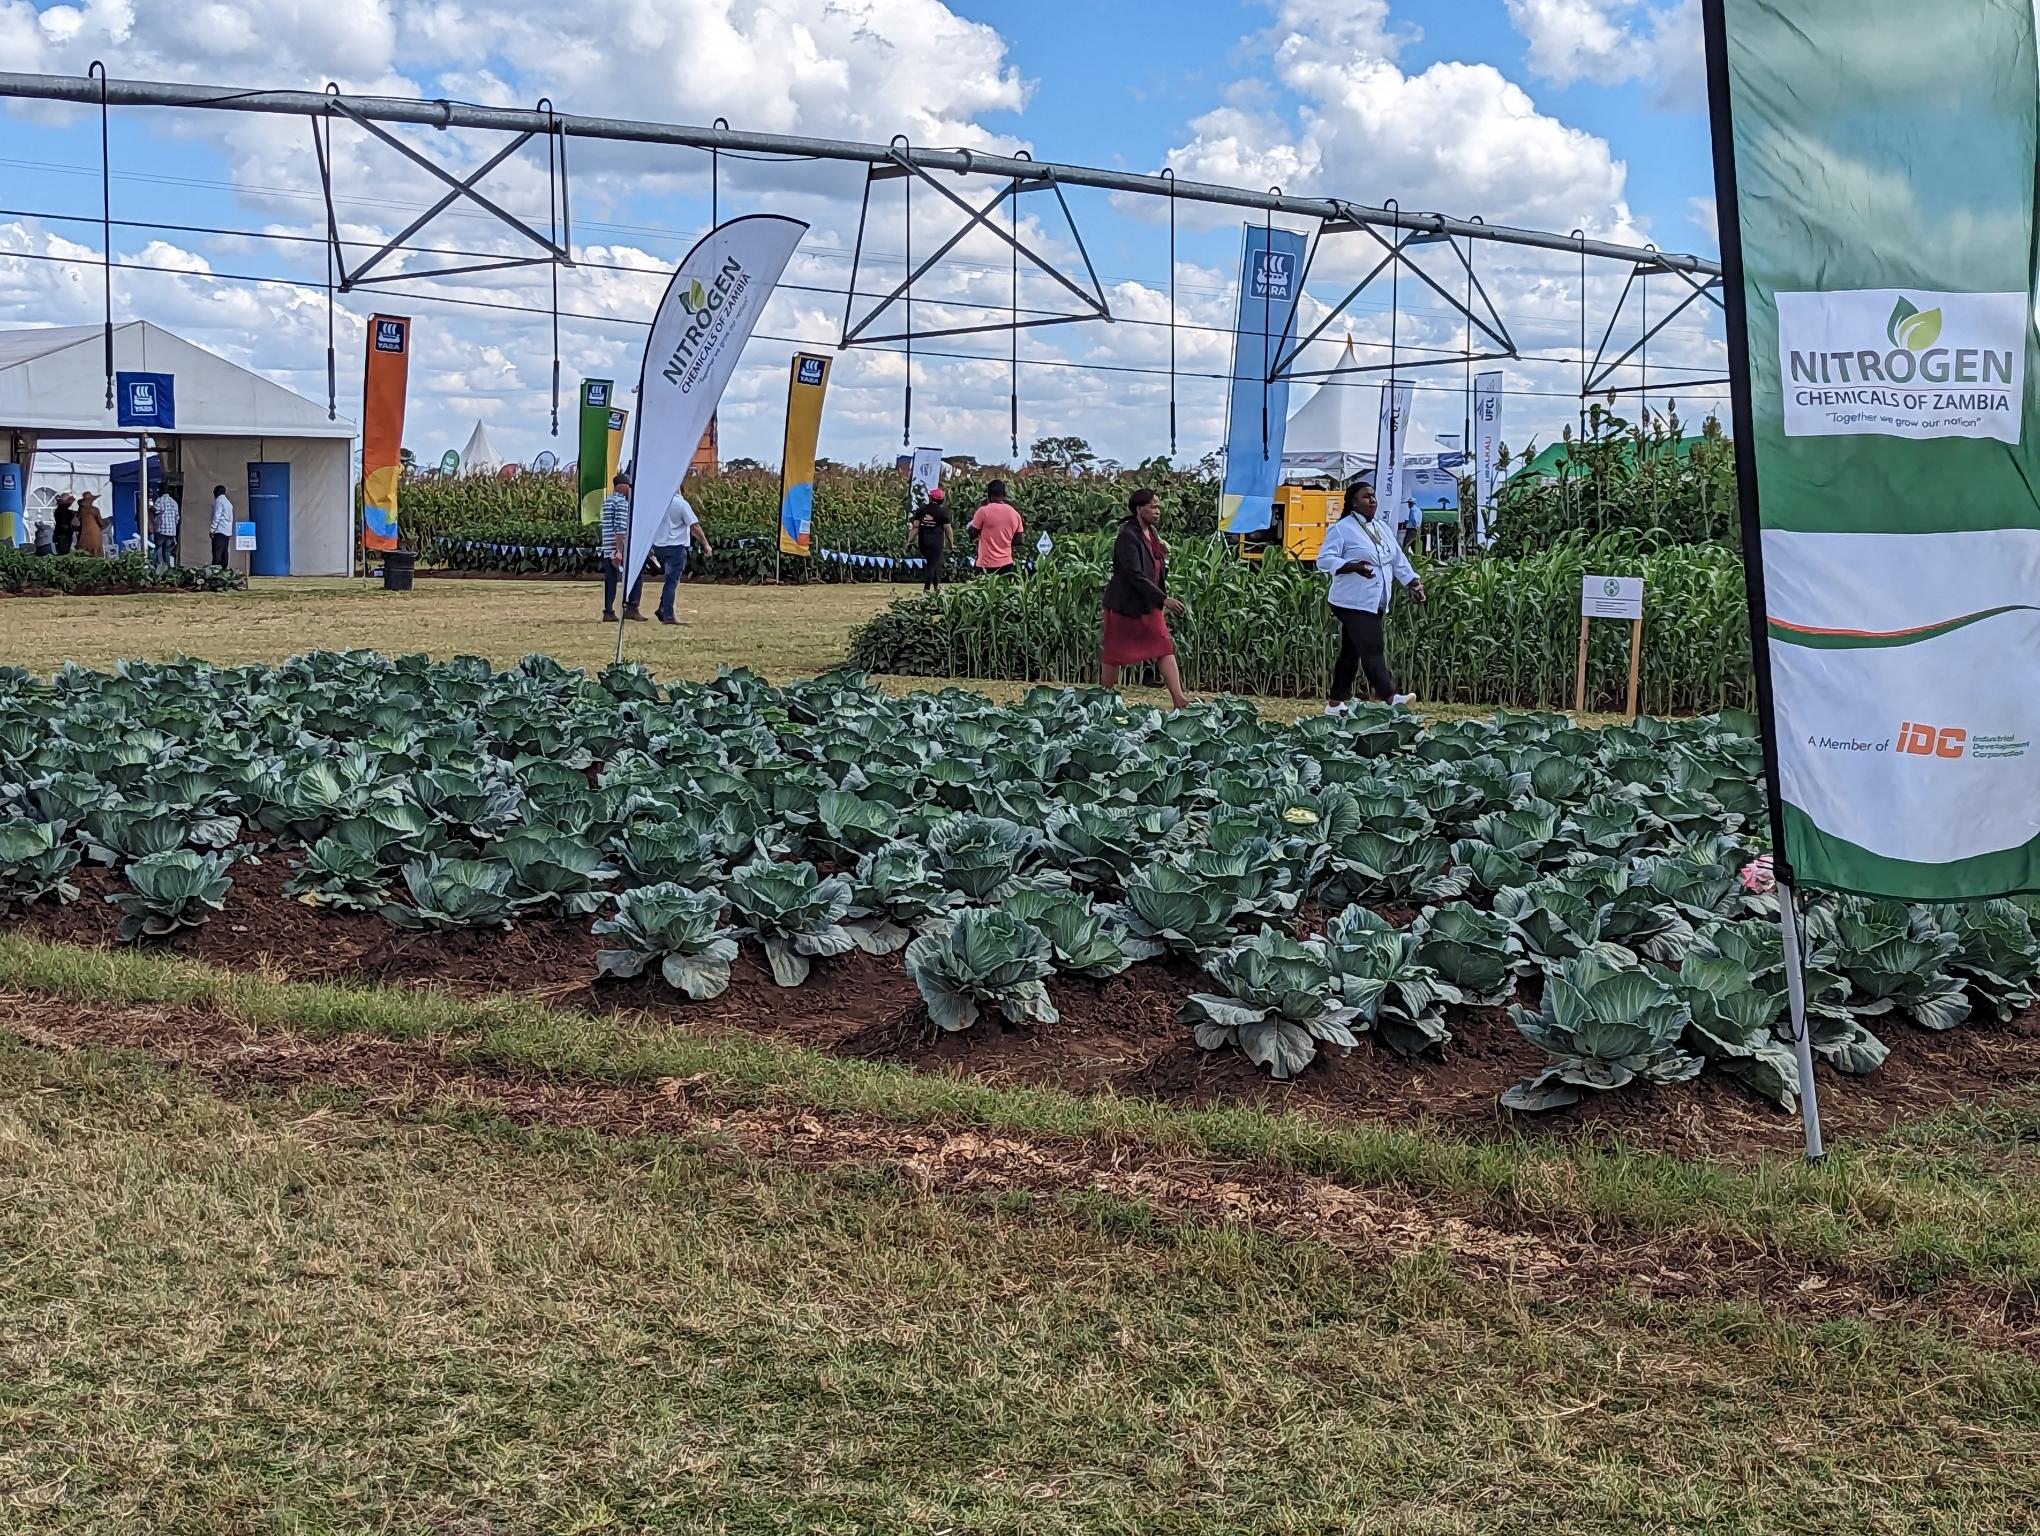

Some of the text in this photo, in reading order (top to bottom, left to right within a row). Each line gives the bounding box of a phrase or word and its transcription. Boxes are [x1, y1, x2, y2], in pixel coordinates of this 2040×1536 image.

[662, 255, 742, 386] NITROGEN
[681, 273, 751, 394] CHEMICALS OF ZAMBIA
[1790, 348, 2013, 384] NITROGEN
[1796, 390, 2009, 411] CHEMICALS OF ZAMBIA
[1880, 415, 1894, 425] we
[1895, 417, 1919, 428] grow
[1922, 419, 1940, 428] our
[1808, 735, 1816, 746] A
[1819, 736, 1872, 752] Member
[1875, 738, 1890, 752] of
